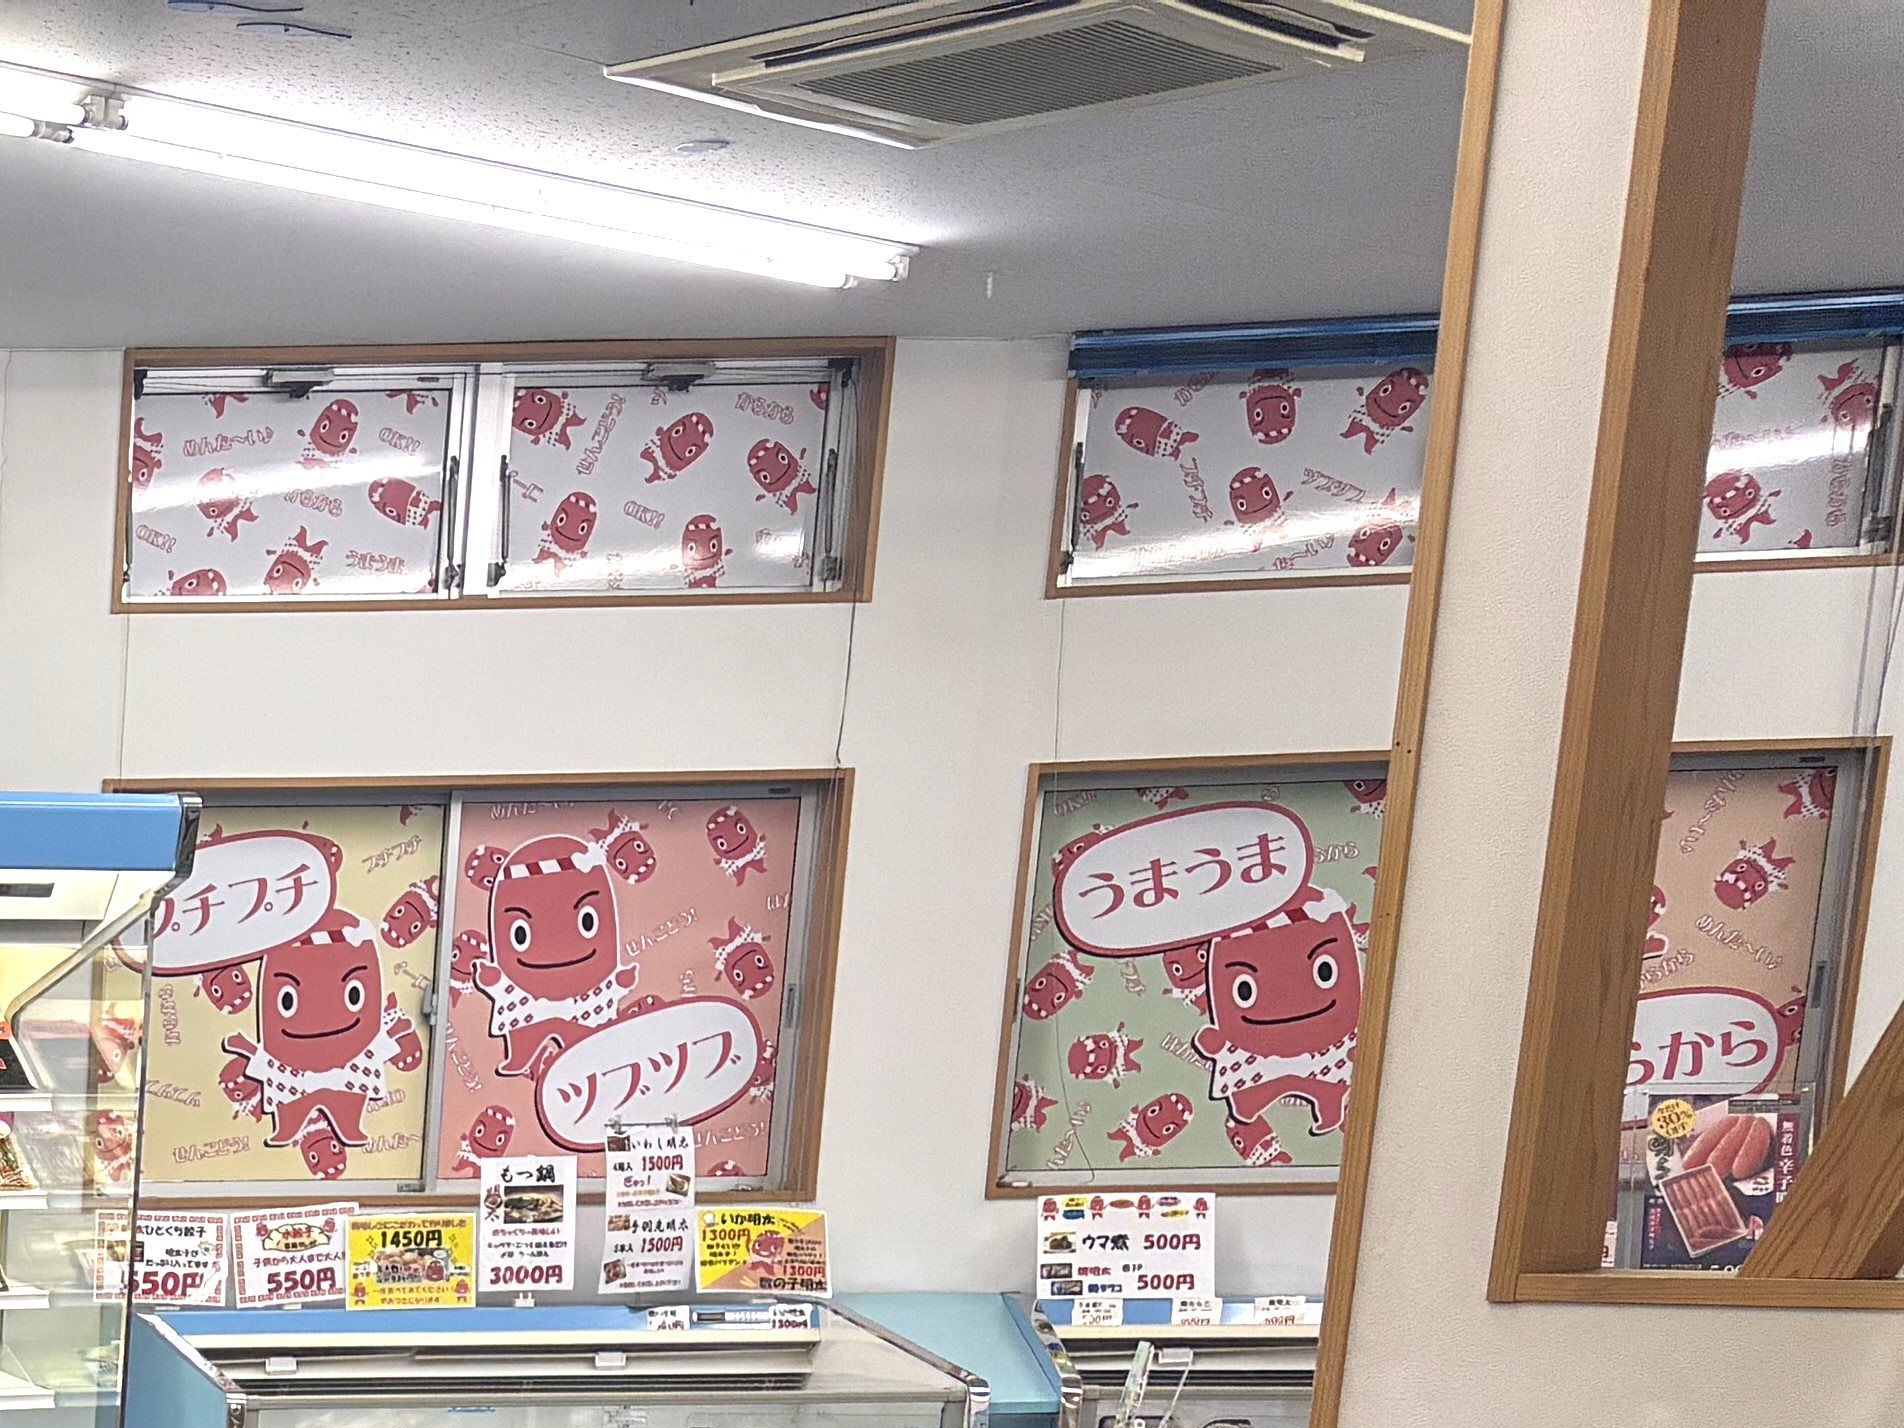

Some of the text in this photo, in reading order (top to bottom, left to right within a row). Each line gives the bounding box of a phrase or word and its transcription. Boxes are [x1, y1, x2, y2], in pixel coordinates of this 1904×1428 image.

[1078, 832, 1287, 919] うまうま
[556, 1031, 742, 1125] ツブツブ
[1656, 1110, 1693, 1131] 30%
[642, 1154, 684, 1172] 1500円
[500, 1164, 556, 1183] もつ鍋
[380, 1228, 443, 1249] 1450円
[640, 1235, 684, 1253] 1500円
[702, 1228, 751, 1241] 1300円
[1143, 1233, 1202, 1251] 500円
[267, 1266, 337, 1293] 550円
[489, 1264, 563, 1285] 3000円
[783, 1265, 826, 1278] 1300円
[1136, 1273, 1195, 1291] 500円
